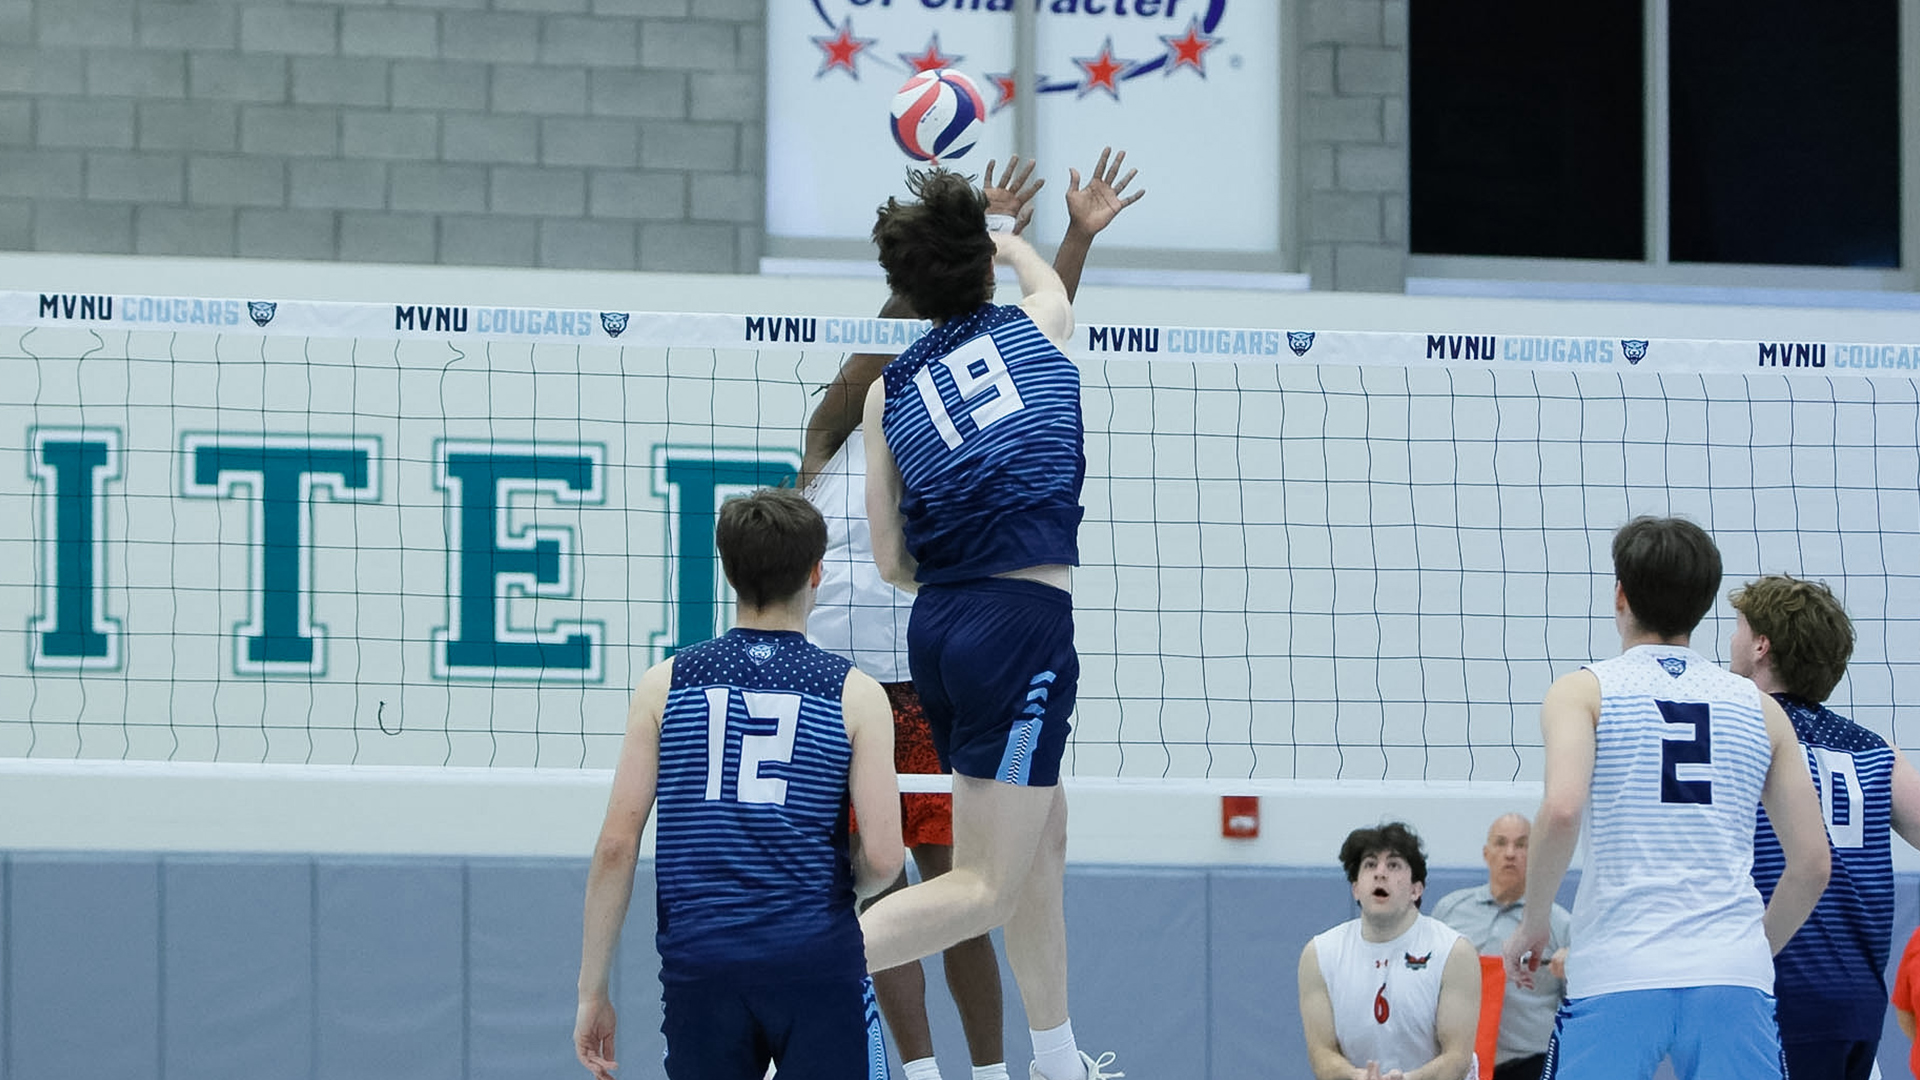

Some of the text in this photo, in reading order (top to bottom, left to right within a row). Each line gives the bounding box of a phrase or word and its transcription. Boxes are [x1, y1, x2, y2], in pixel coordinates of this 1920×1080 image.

[39, 294, 240, 326] MVNU COUGARS
[395, 306, 593, 337] MVNU COUGARS
[745, 317, 817, 343] MVNU
[1088, 327, 1279, 356] MVNU COUGARS
[1426, 334, 1614, 364] MVNU COUGARS
[1758, 343, 1826, 368] MVNU
[912, 333, 1026, 451] 19
[704, 687, 802, 806] 12
[1654, 700, 1712, 805] 2
[1800, 744, 1865, 849] 0
[1373, 982, 1390, 1024] 6
